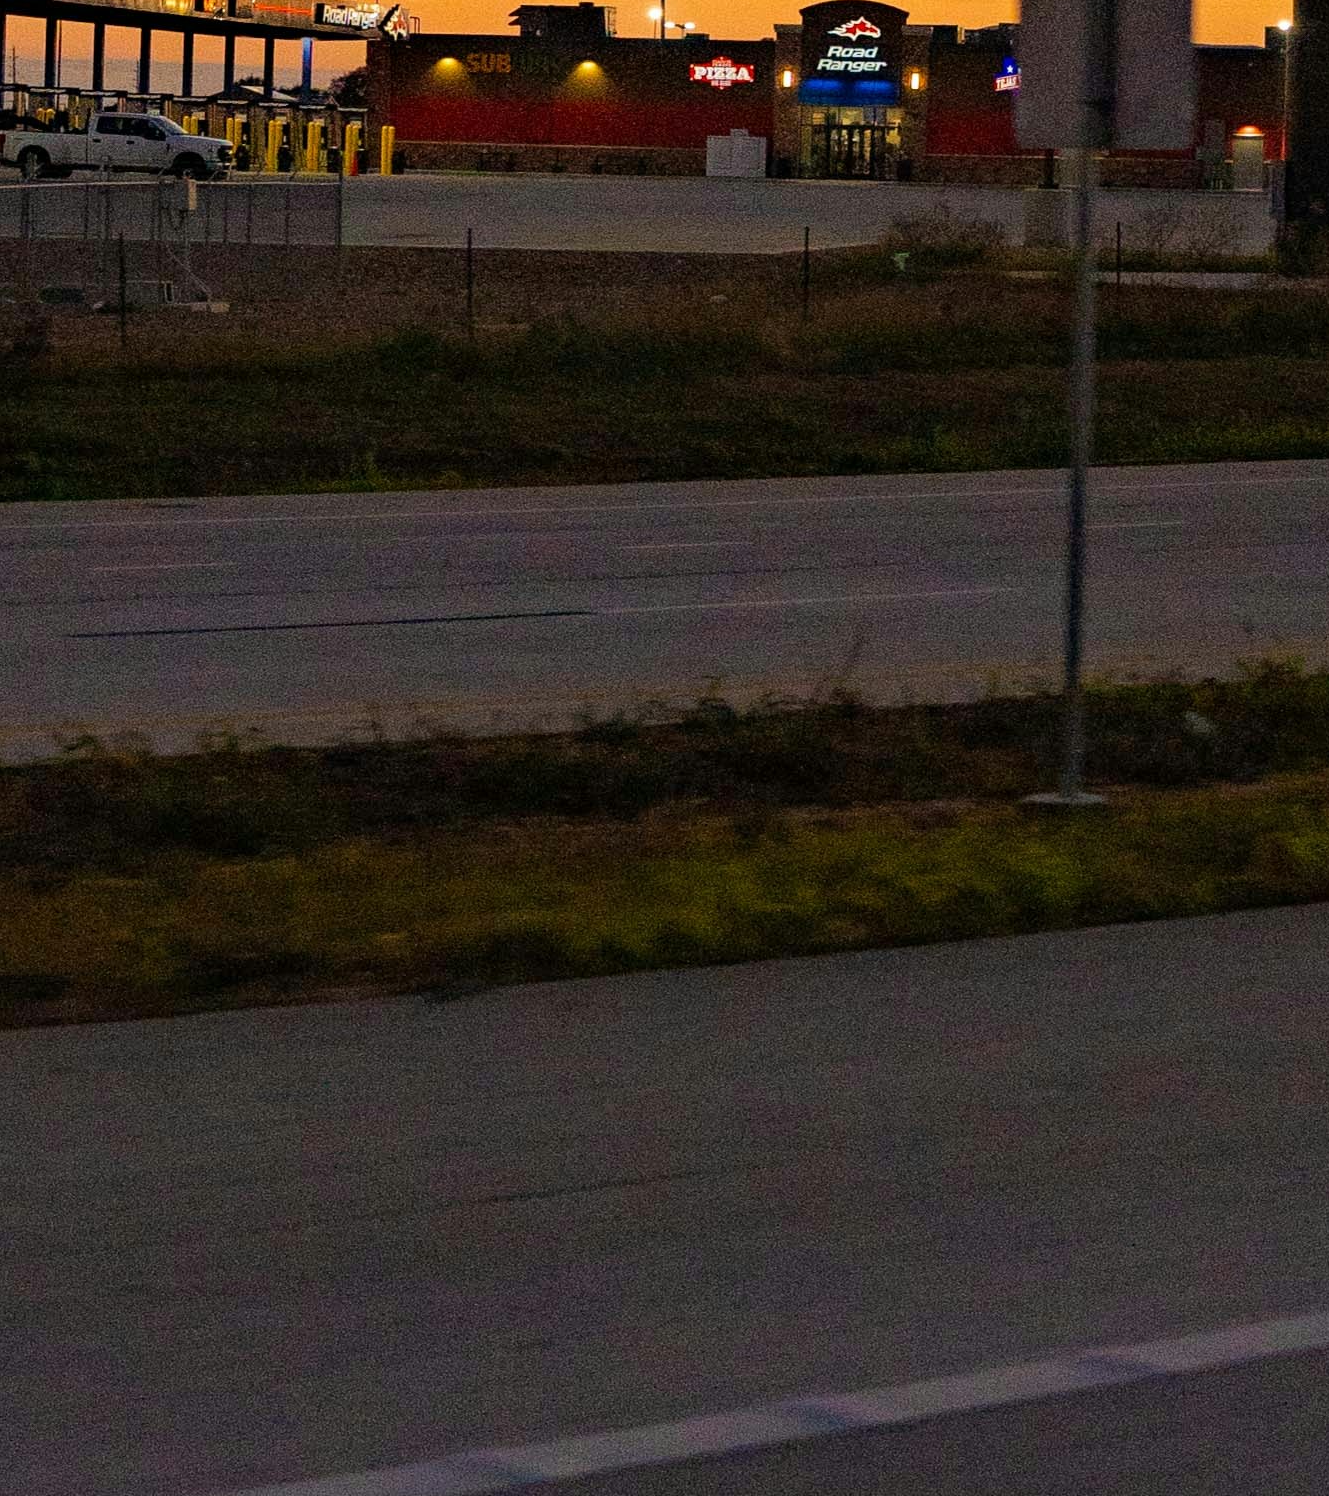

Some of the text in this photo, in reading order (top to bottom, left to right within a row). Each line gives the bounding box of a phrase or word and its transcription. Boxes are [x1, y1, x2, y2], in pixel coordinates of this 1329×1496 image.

[826, 45, 879, 58] Road
[816, 58, 888, 73] Ranger
[693, 66, 751, 81] PIZZA
